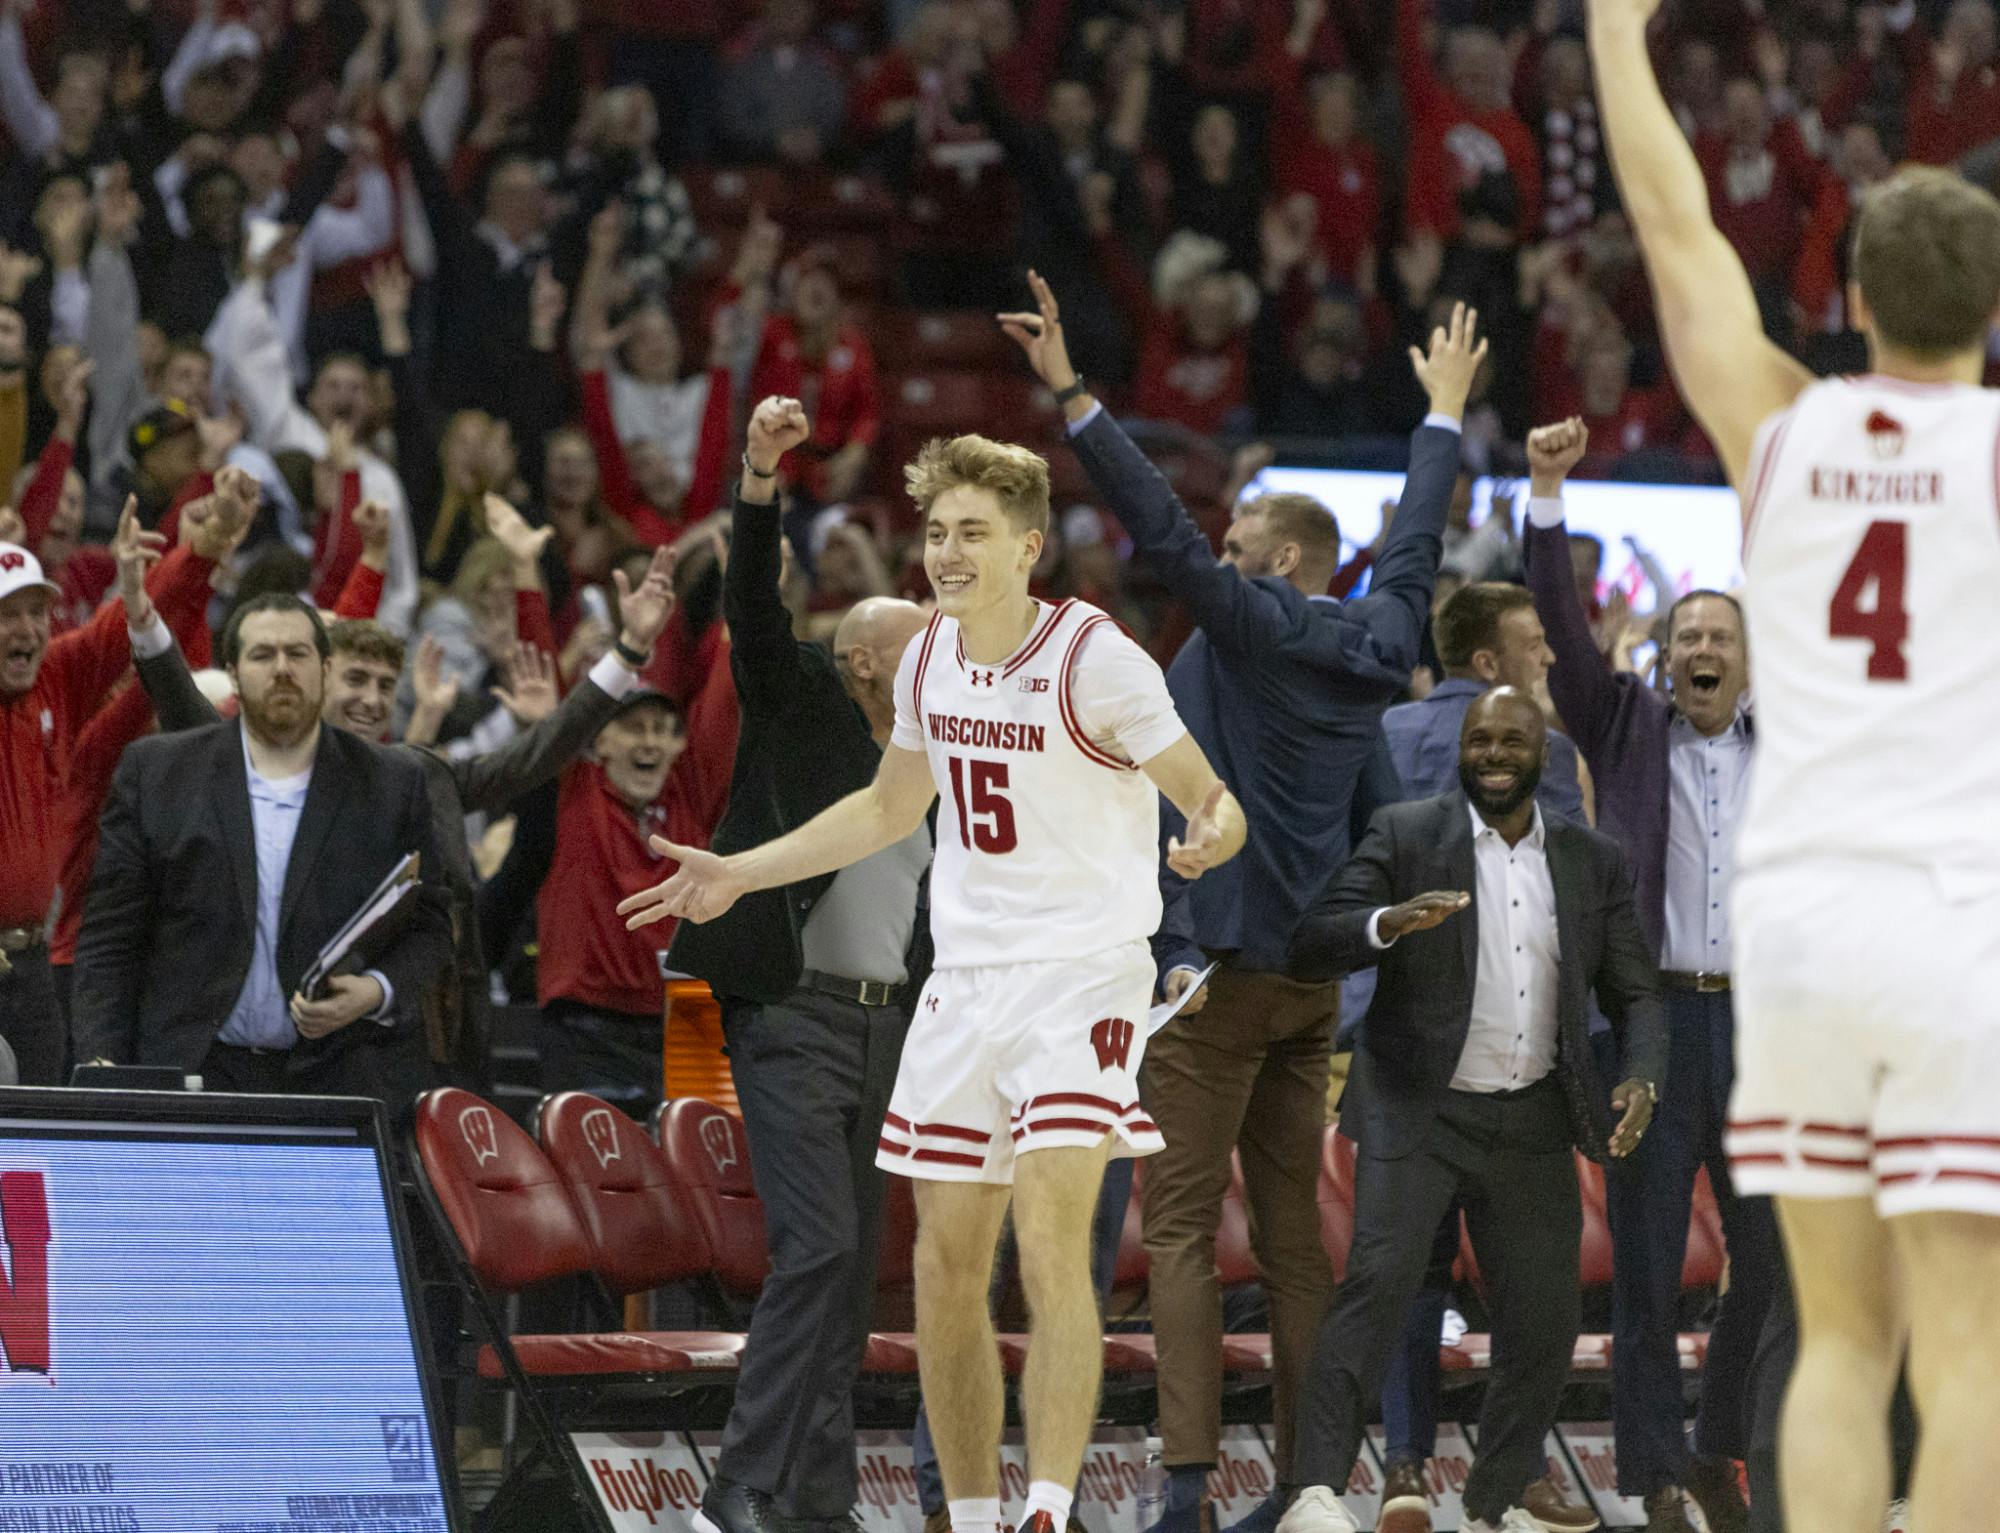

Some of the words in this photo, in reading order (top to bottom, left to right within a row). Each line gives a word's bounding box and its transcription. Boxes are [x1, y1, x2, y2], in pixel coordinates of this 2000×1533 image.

[1829, 519, 1911, 682] 4
[928, 713, 1045, 752] WISCONSIN
[948, 756, 1018, 855] 15
[1090, 1017, 1134, 1074] W
[8, 1463, 91, 1494] PARTNER
[94, 1462, 115, 1494] OF
[45, 1504, 140, 1533] ATHLETICS
